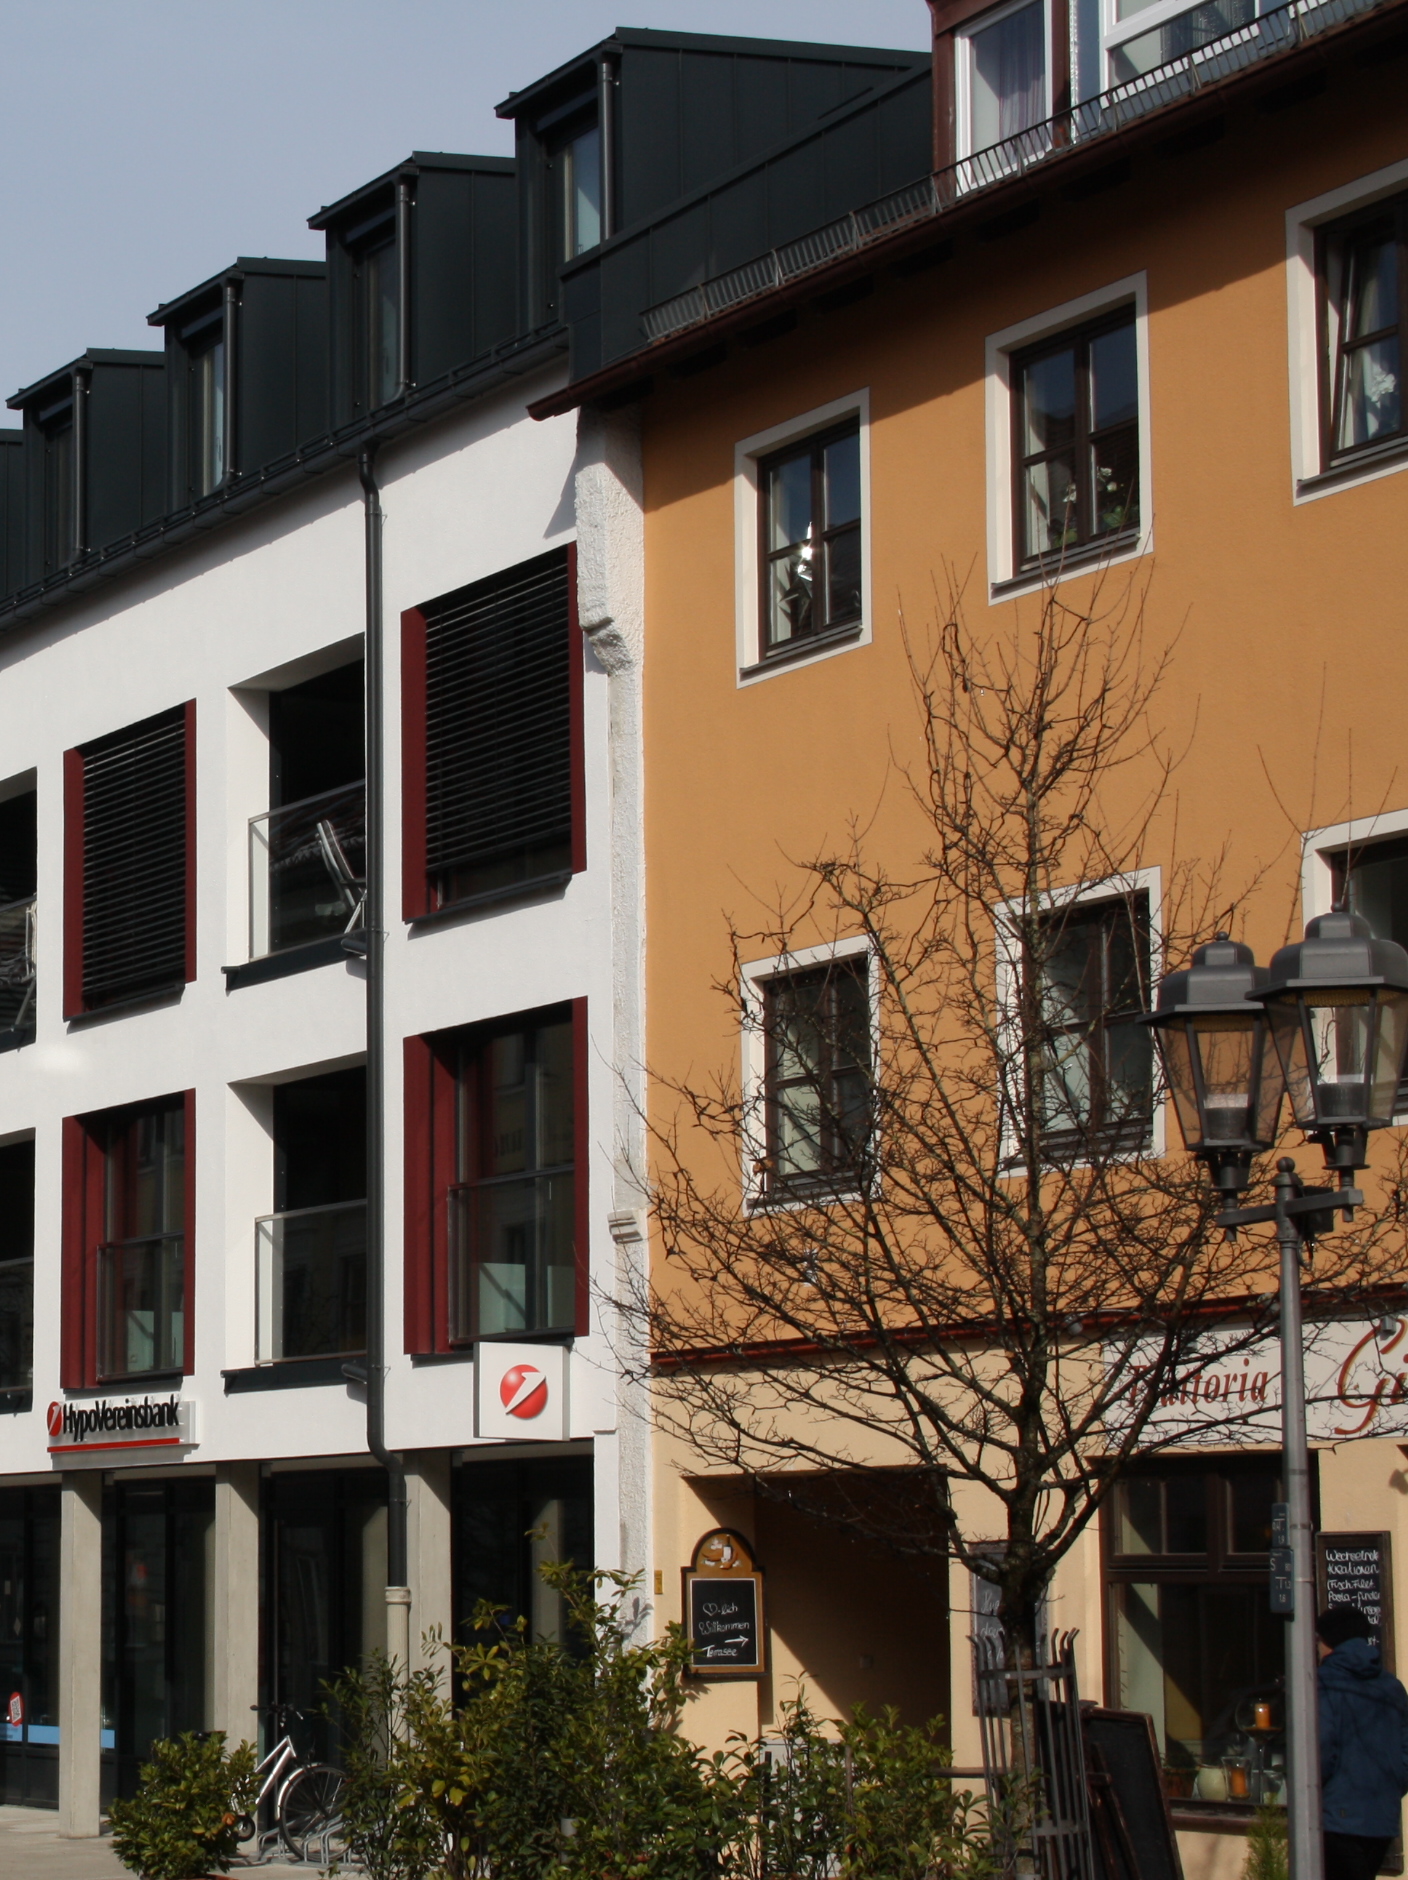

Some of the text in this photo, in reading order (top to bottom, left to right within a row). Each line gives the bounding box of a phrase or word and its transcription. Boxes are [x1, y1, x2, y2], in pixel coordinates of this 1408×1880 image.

[1127, 1358, 1269, 1407] Tttoria
[63, 1394, 180, 1443] HypoVereinsbank
[698, 1621, 750, 1636] Willkommen
